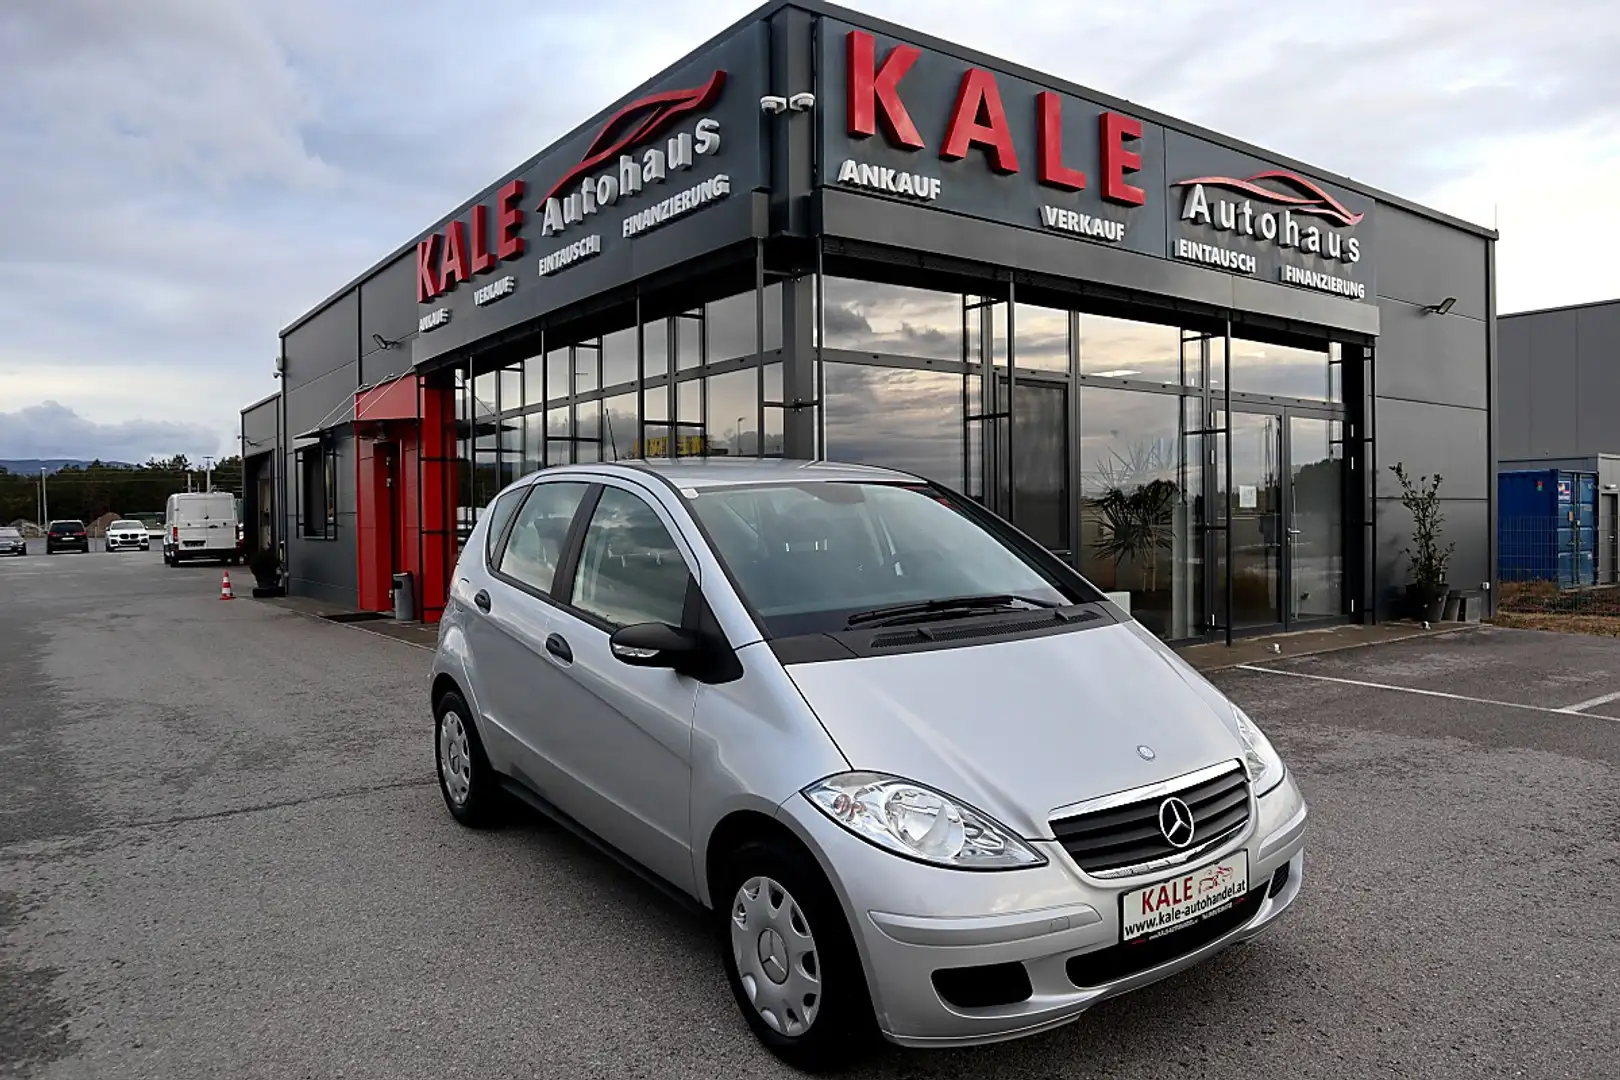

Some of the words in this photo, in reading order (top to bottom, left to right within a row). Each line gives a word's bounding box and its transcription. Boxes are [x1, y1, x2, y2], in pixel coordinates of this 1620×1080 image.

[846, 30, 1146, 206] KALE
[541, 118, 720, 237] Autohaus
[837, 159, 941, 199] ANKAUF
[622, 174, 730, 238] FINANZIERUNG
[1039, 205, 1125, 241] VERKAUF
[1181, 183, 1361, 263] Autohaus
[417, 179, 525, 303] KALE
[538, 234, 601, 276] EINTAUSCH
[1175, 239, 1256, 273] EINTAUSCH
[473, 276, 515, 306] VERKAUF
[1280, 265, 1365, 298] FINANZIERUNG
[1125, 879, 1246, 937] www.kale-autohandel.at
[1142, 876, 1193, 915] KALE
